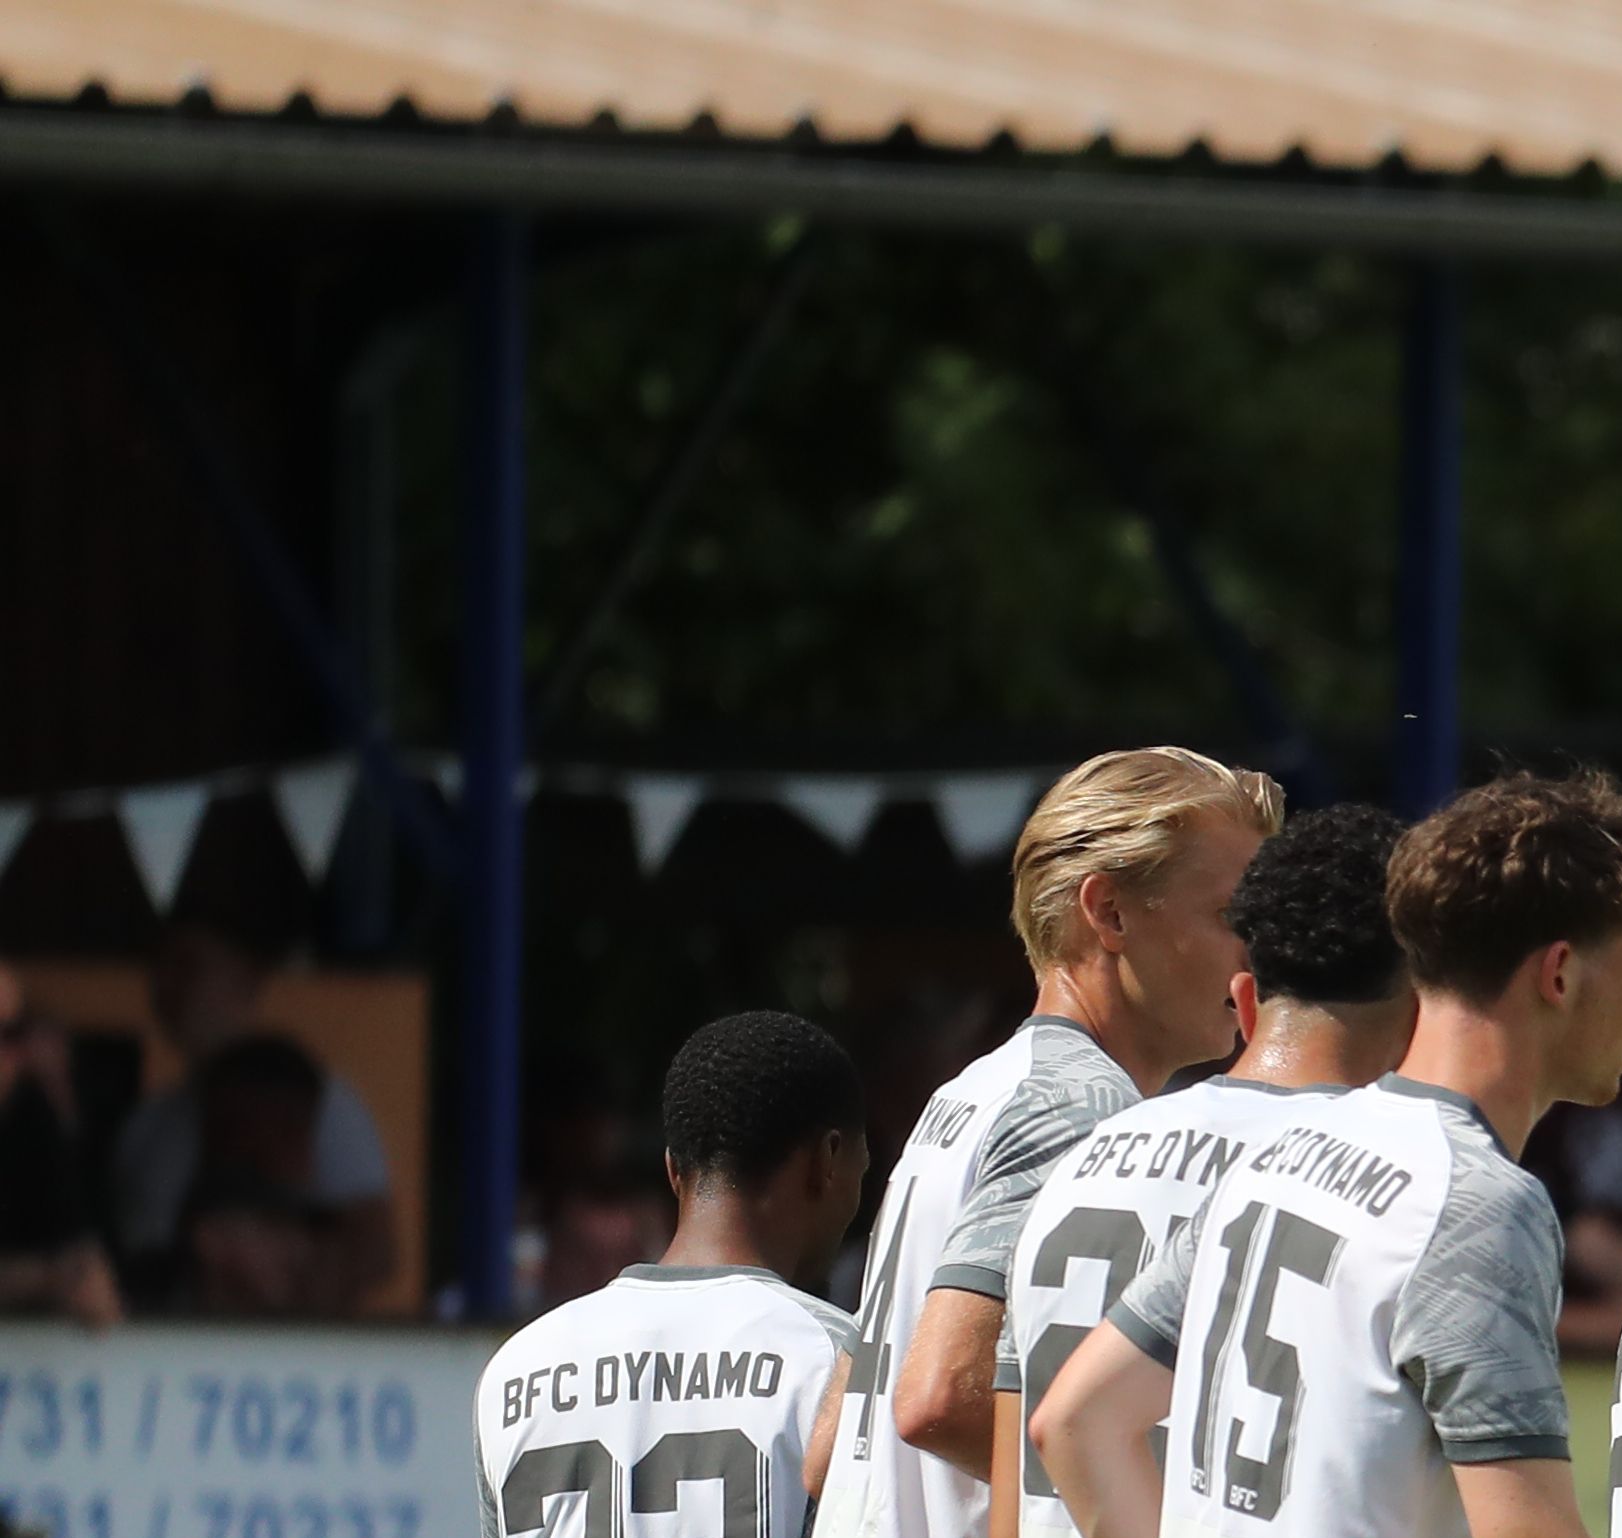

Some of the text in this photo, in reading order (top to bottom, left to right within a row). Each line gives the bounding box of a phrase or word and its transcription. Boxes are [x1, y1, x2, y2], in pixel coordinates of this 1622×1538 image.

[1073, 1131, 1151, 1180] BFC
[503, 1351, 785, 1429] BFC DYNAMO
[1191, 1199, 1349, 1521] 15
